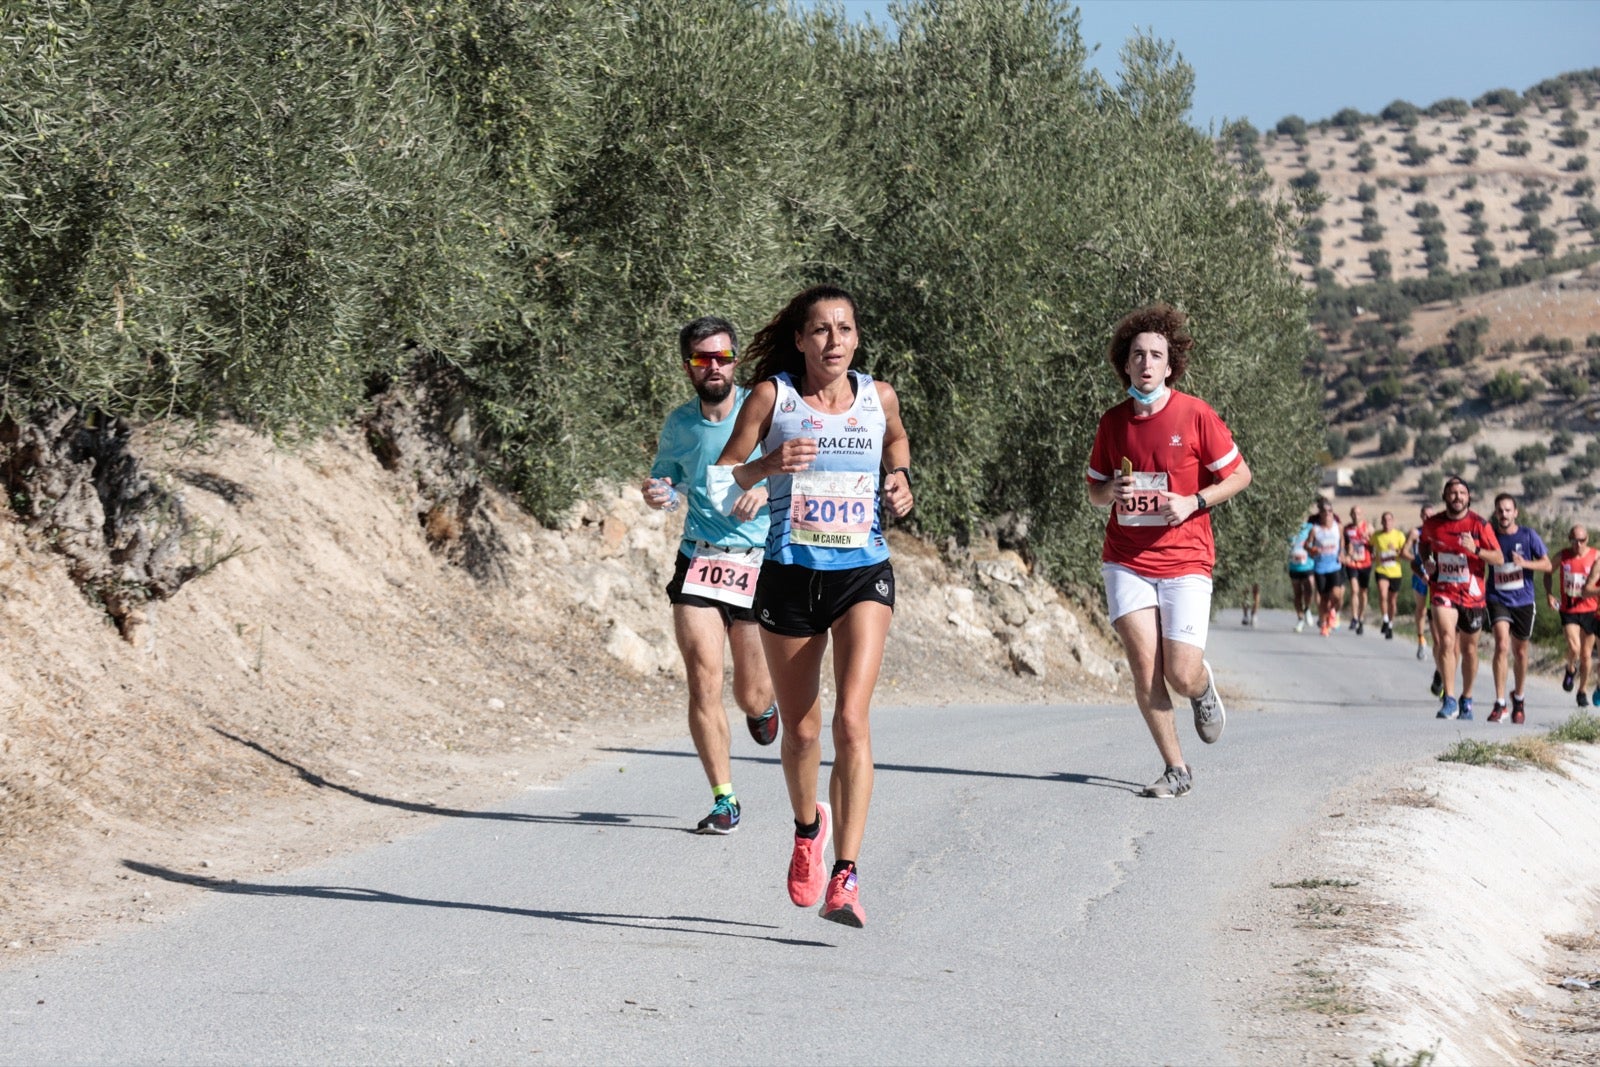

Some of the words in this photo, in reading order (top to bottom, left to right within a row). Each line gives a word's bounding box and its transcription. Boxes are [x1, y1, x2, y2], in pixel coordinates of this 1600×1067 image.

[818, 437, 872, 449] RACENA
[804, 499, 865, 523] 2019
[813, 534, 820, 542] M
[821, 535, 851, 544] CARMEN
[1443, 563, 1465, 573] 2047
[699, 566, 749, 591] 1034
